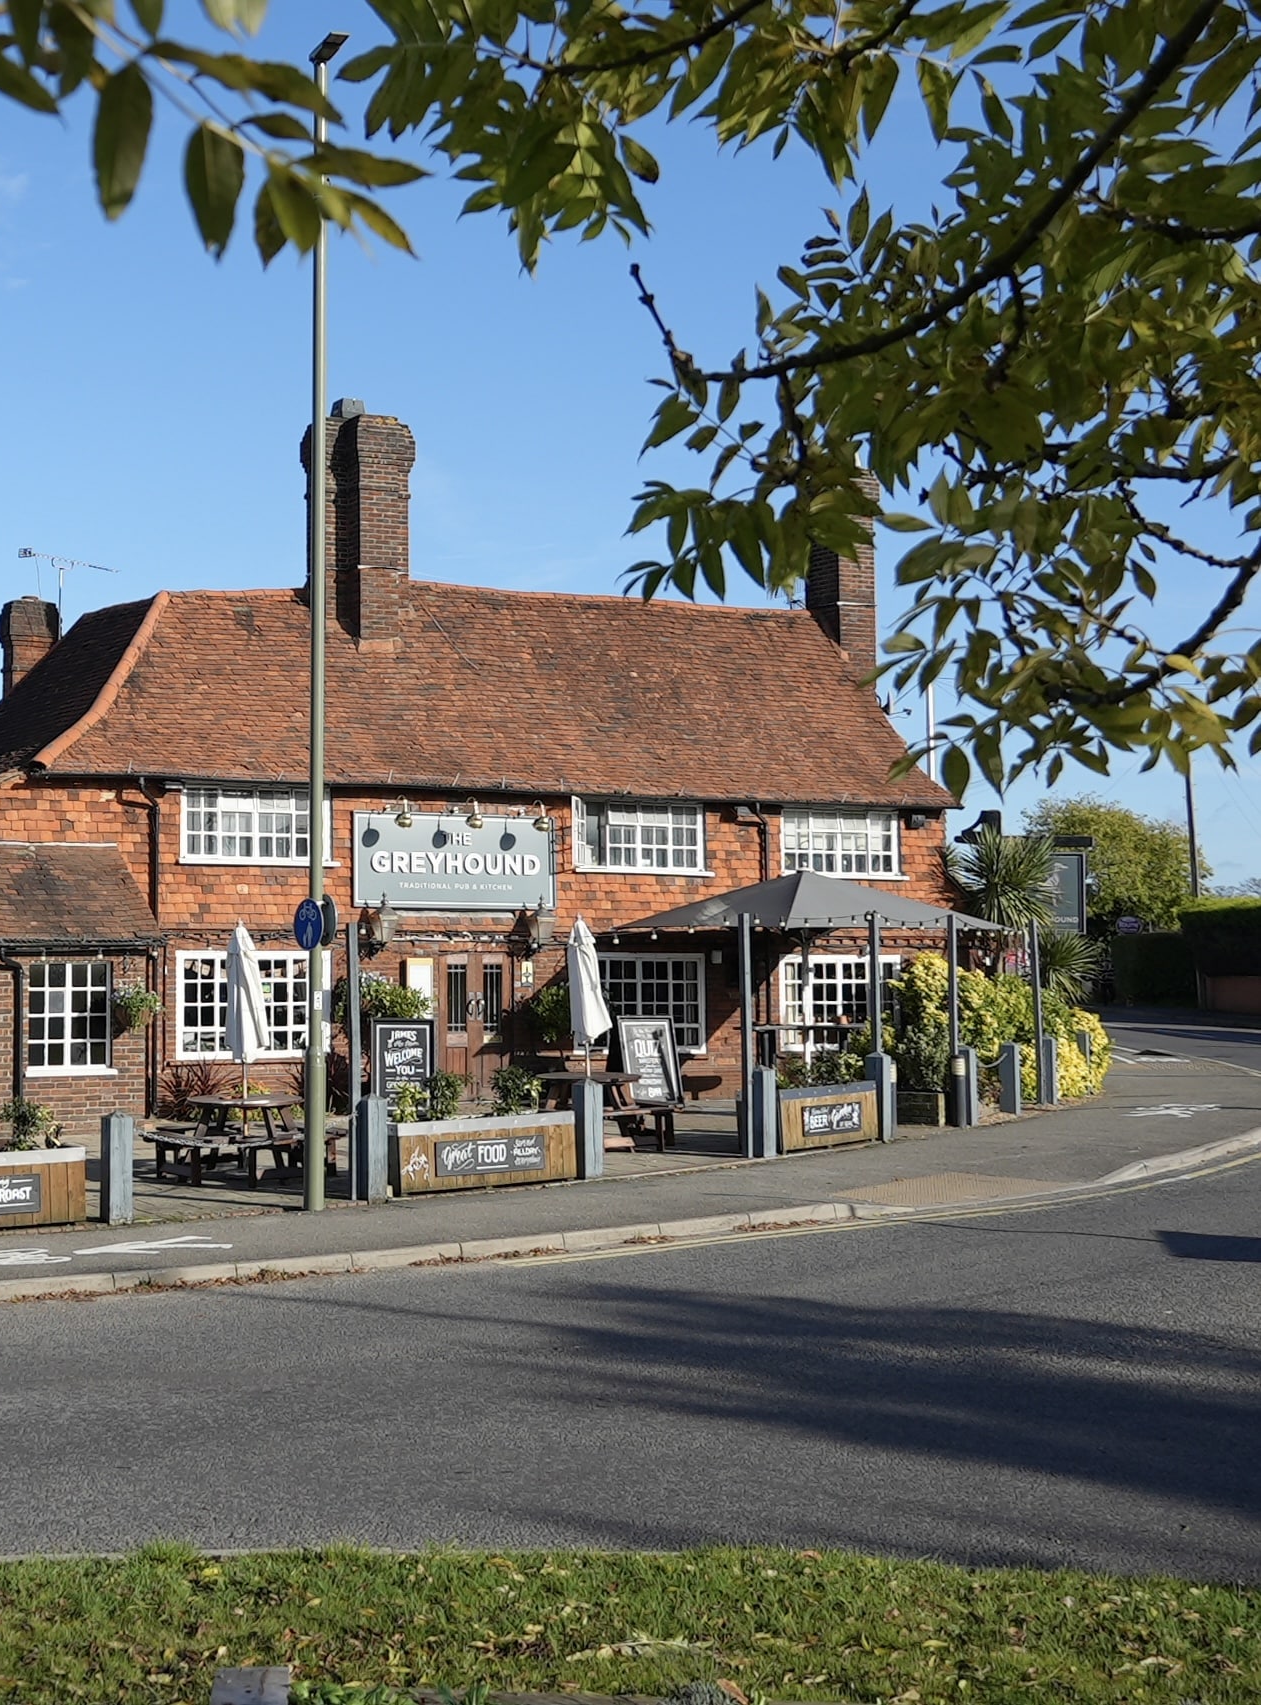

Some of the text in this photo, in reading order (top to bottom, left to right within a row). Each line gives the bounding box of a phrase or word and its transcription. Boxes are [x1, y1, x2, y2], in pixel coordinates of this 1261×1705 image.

[443, 832, 473, 846] THE
[371, 850, 541, 876] GREYHOUND
[399, 882, 451, 890] TRADITIONAL
[390, 1031, 417, 1042] JAMES
[634, 1039, 660, 1058] QUIZ
[384, 1048, 423, 1067] WELCOME
[395, 1065, 415, 1075] YOU
[442, 1142, 507, 1170] Great FOOD
